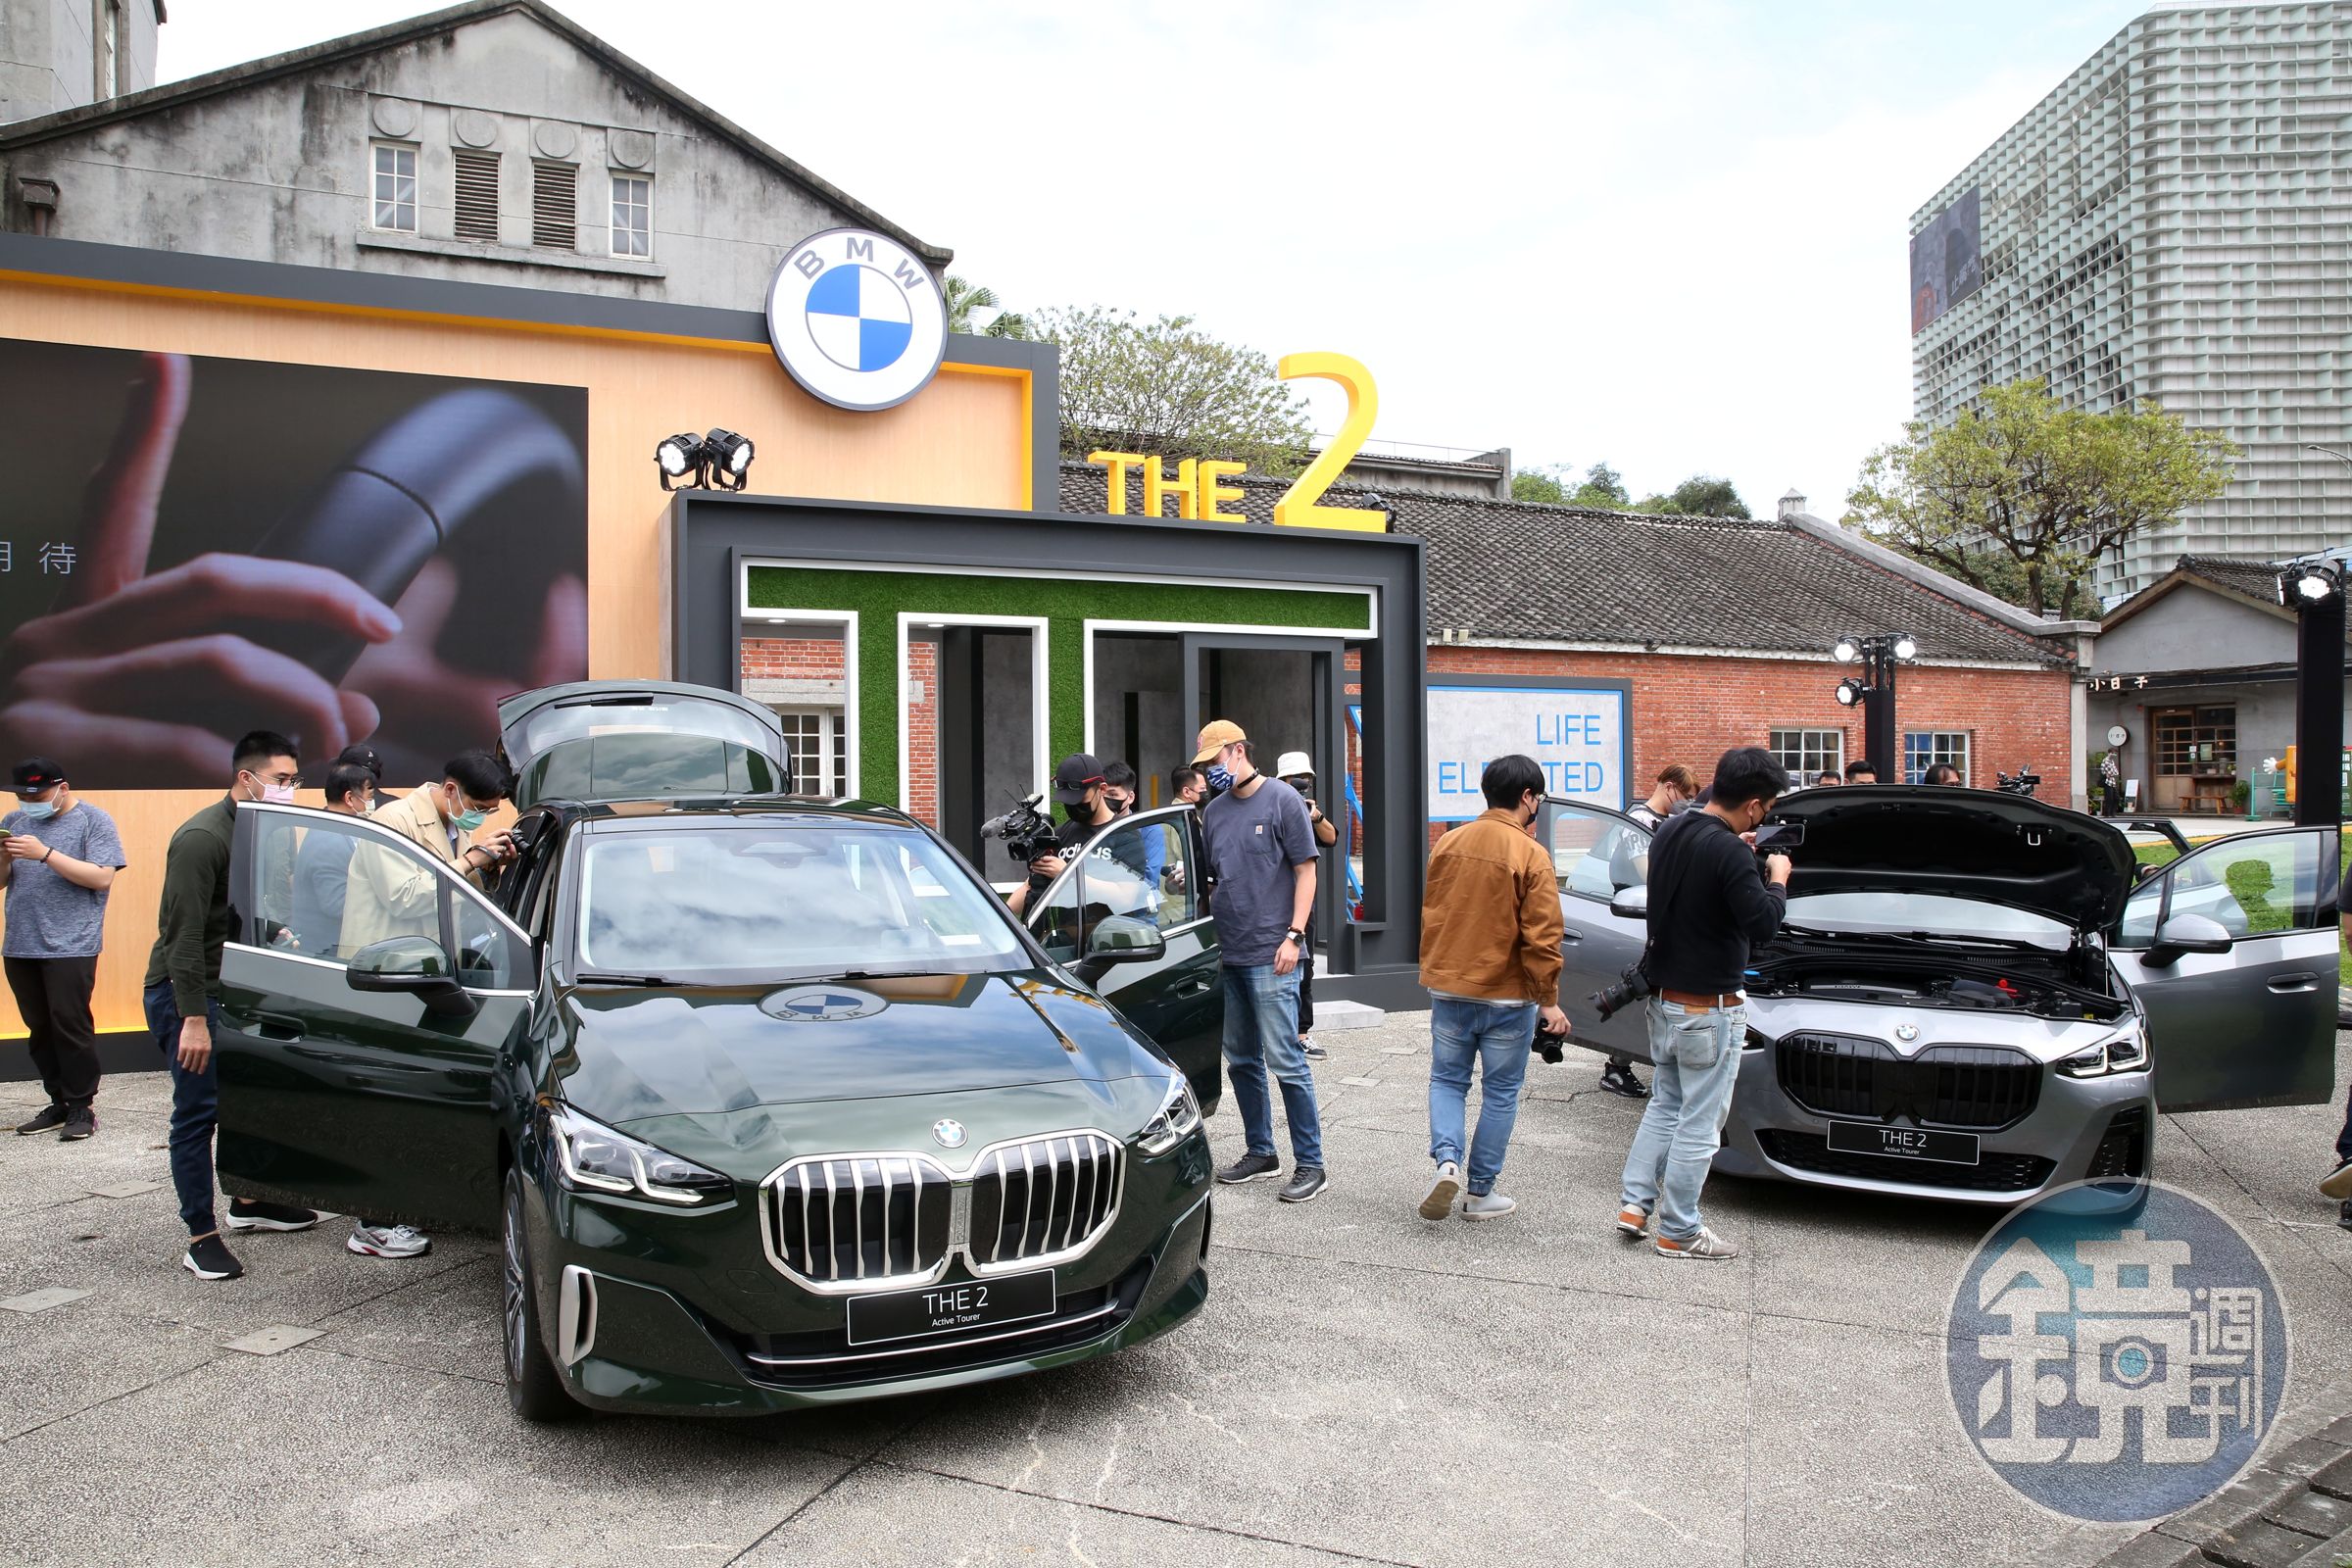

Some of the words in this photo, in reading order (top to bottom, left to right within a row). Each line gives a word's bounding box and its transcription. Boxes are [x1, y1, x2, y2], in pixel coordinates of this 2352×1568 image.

[794, 237, 924, 290] BMW
[1088, 451, 1247, 523] THE
[1274, 351, 1387, 533] 2
[1537, 714, 1601, 745] LIFE
[1439, 761, 1603, 793] ELTED
[1879, 1130, 1913, 1147] THE
[1916, 1133, 1927, 1148] 2
[922, 1289, 971, 1314] THE
[976, 1286, 989, 1307] 2
[931, 1316, 955, 1327] Active
[956, 1313, 981, 1324] Tourer
